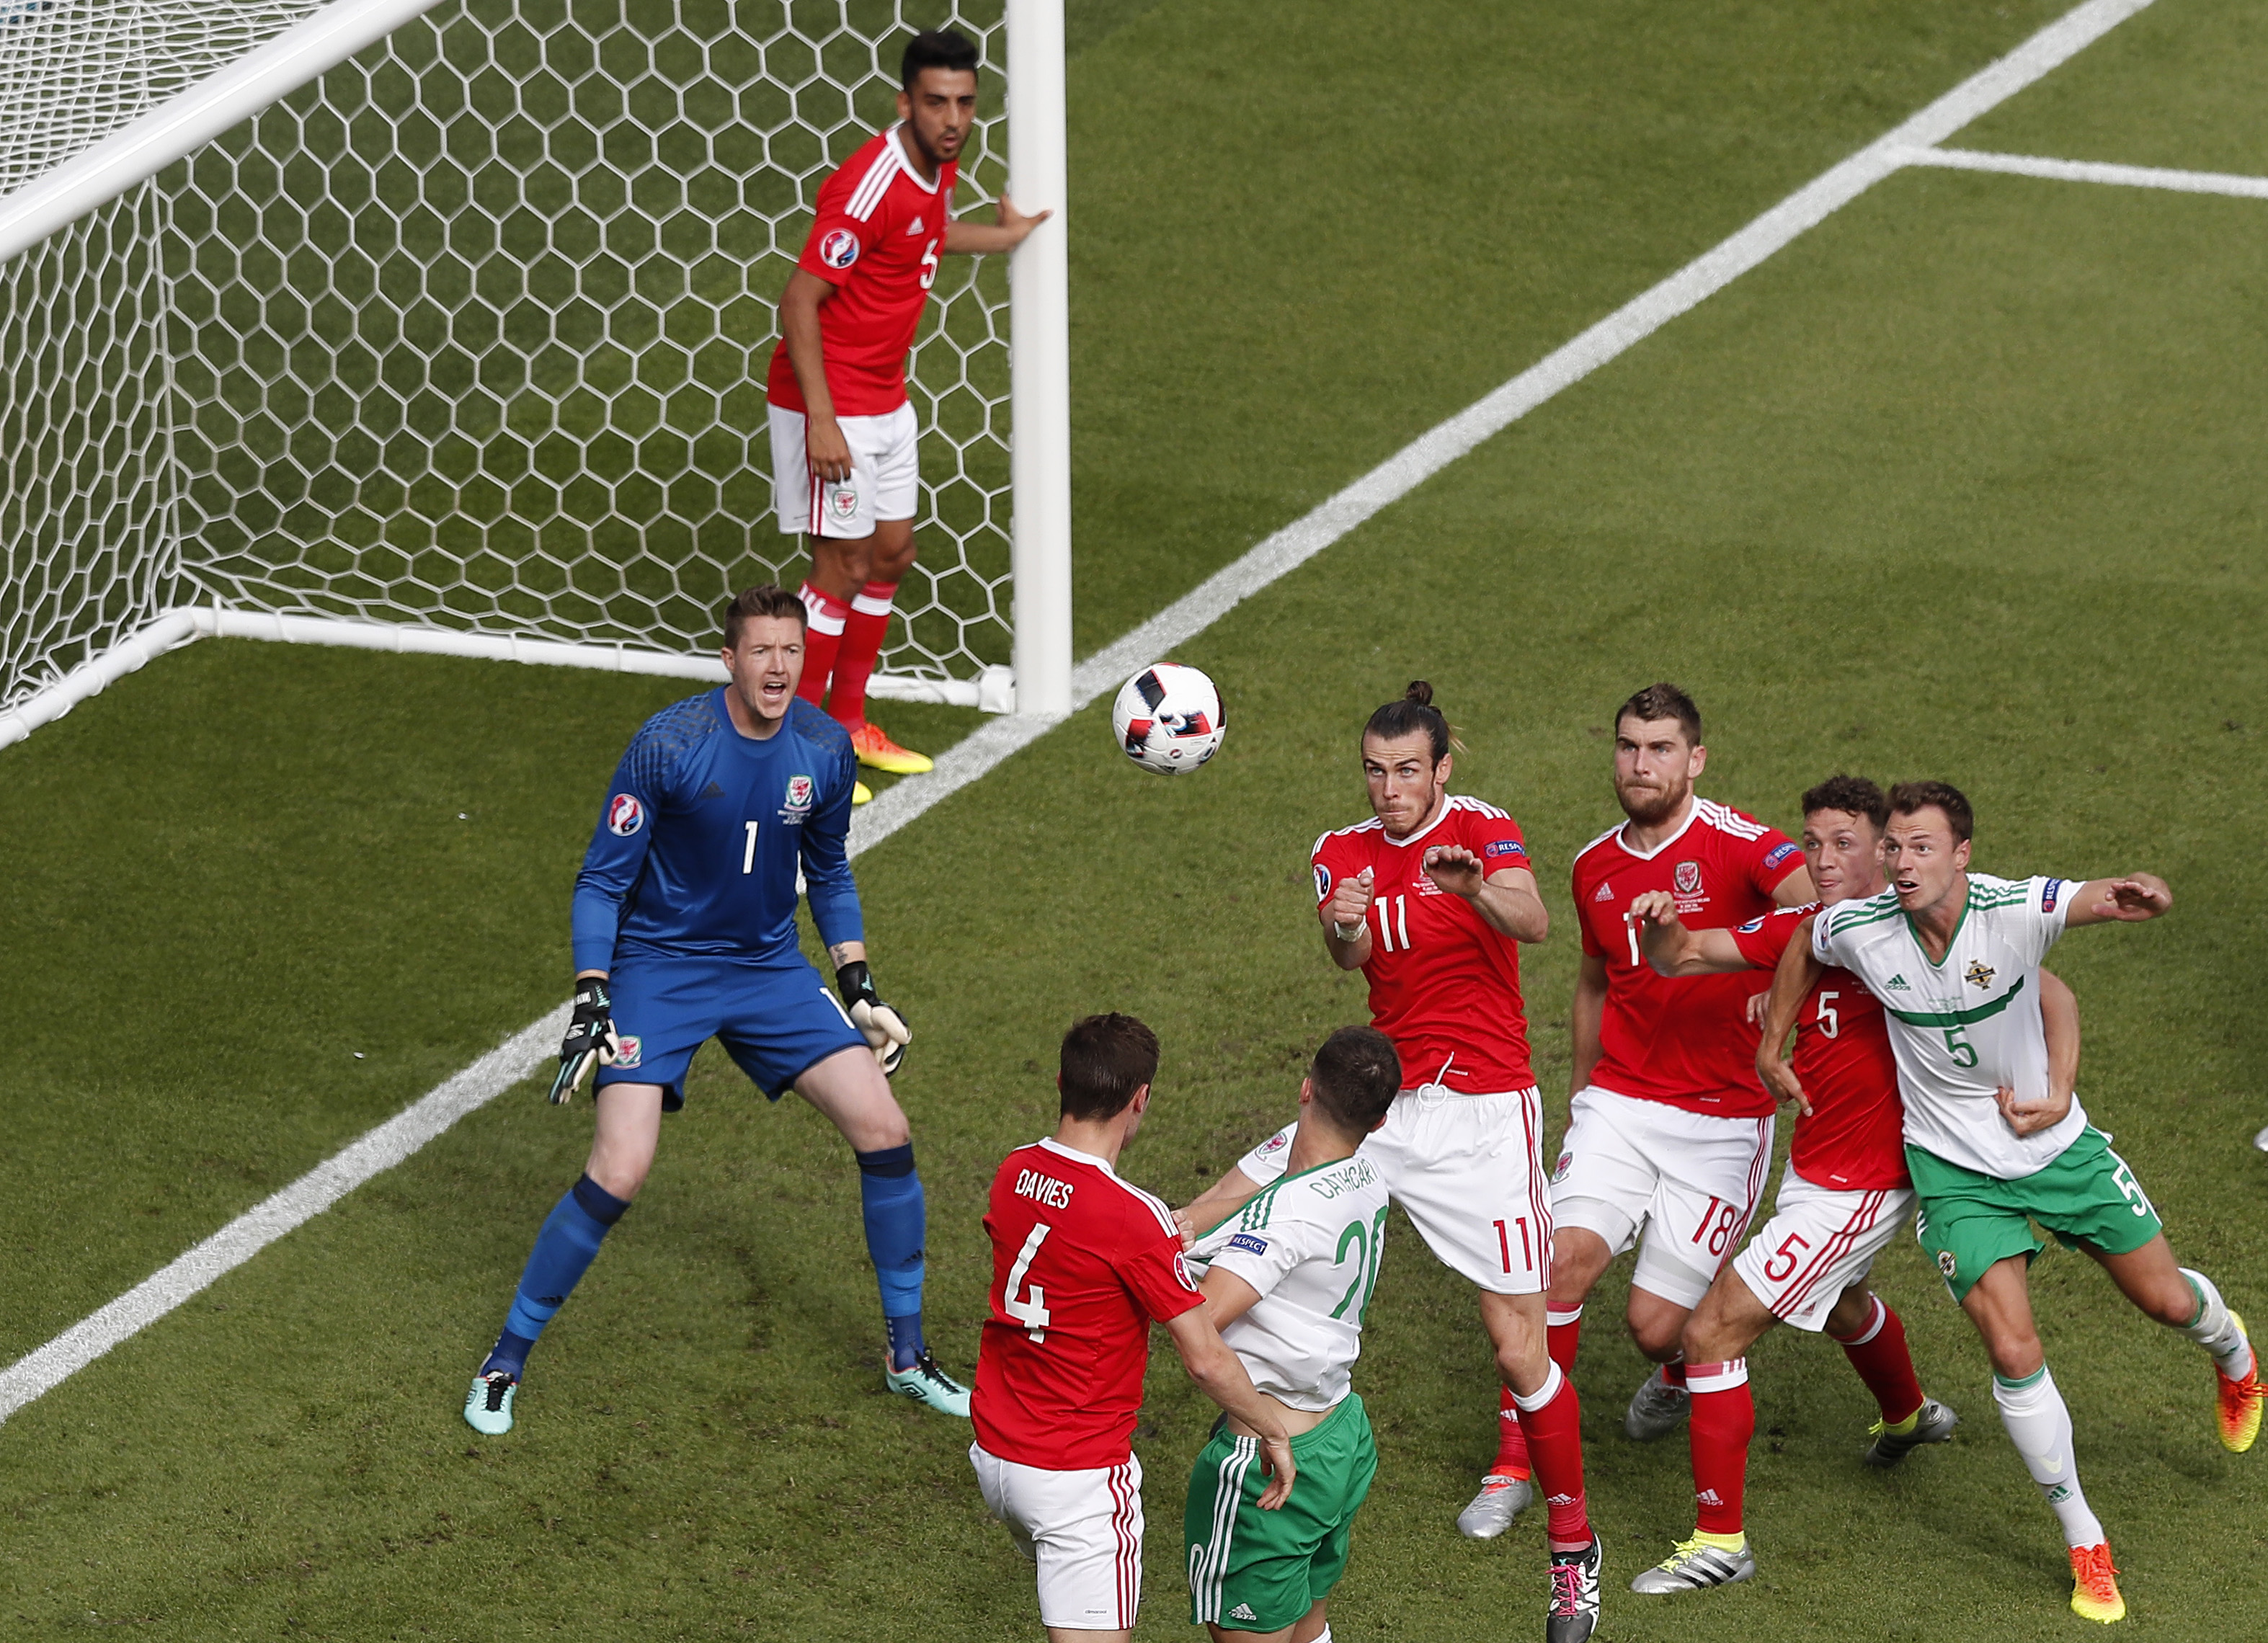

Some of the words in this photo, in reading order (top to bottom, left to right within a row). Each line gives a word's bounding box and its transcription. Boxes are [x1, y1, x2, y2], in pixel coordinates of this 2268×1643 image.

[920, 238, 938, 290] 5
[743, 820, 758, 874] 1
[1374, 894, 1410, 952] 11
[819, 987, 857, 1029] 1
[1816, 991, 1839, 1039] 5
[1943, 1025, 1979, 1068] 5
[1015, 1169, 1074, 1209] DAVIES
[2110, 1166, 2148, 1217] 5
[1493, 1216, 1533, 1274] 11
[1692, 1195, 1735, 1257] 18
[1765, 1232, 1810, 1281] 5
[1005, 1222, 1051, 1345] 4
